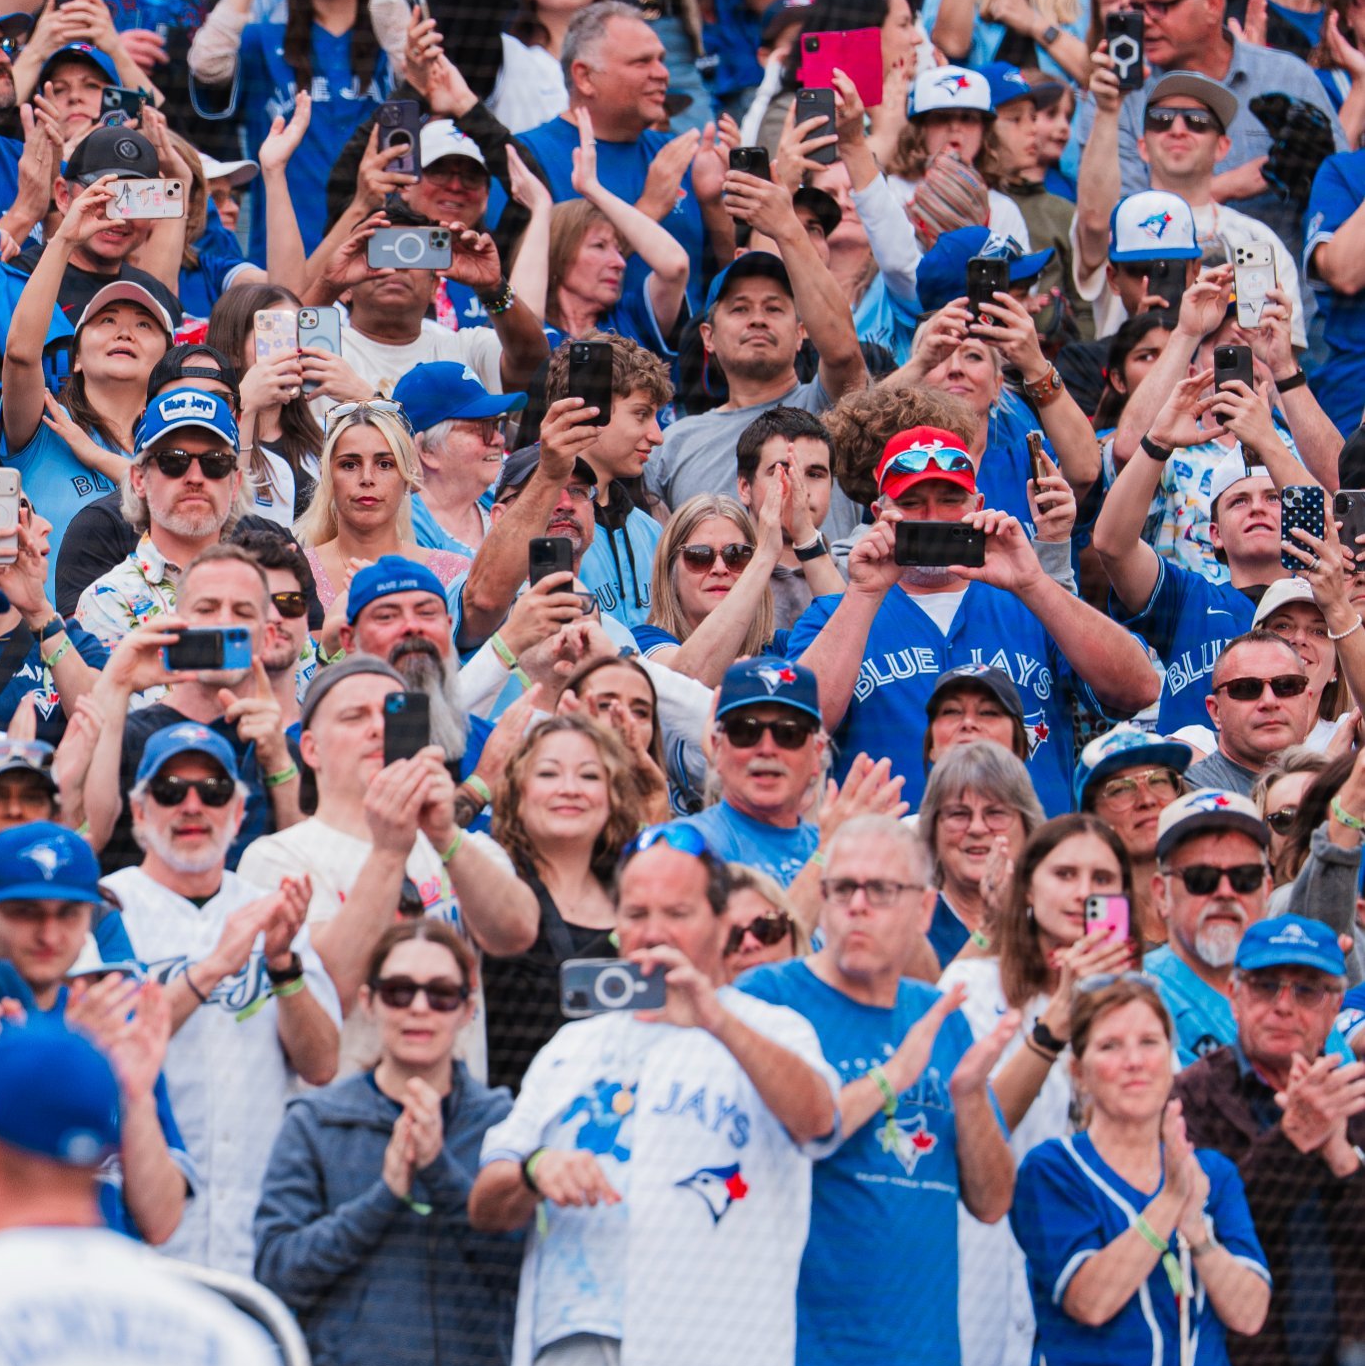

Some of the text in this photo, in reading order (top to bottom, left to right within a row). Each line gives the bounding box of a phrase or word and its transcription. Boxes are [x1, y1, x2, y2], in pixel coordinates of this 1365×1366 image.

[854, 646, 941, 704] BLUE
[1165, 638, 1231, 697] BLU
[651, 1080, 751, 1150] JAYS
